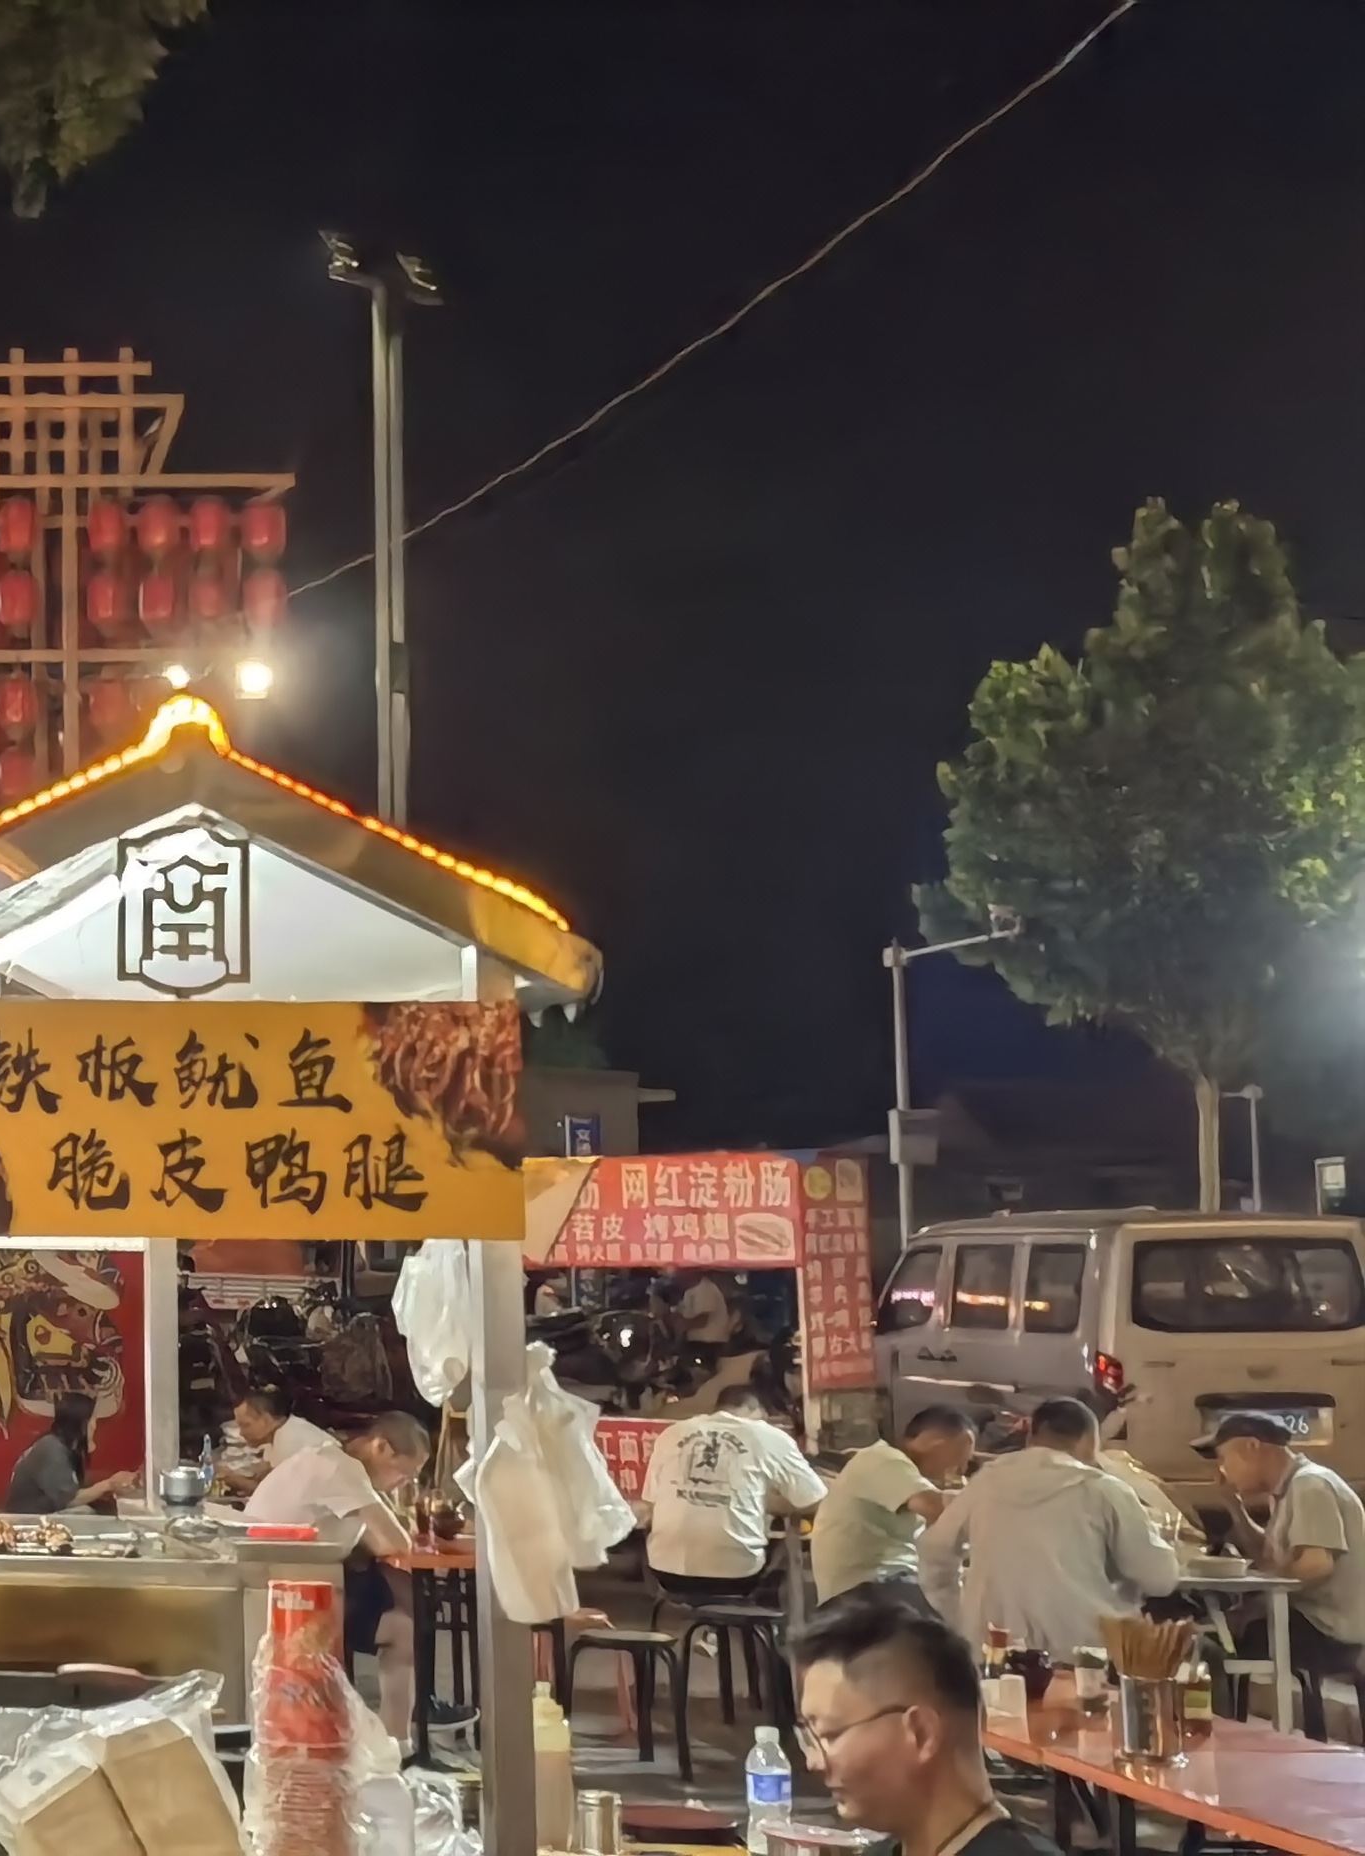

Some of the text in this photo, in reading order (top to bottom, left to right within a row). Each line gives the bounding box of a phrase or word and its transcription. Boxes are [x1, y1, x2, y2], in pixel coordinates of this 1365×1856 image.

[48, 1124, 429, 1214] 脆皮鸭腿
[621, 1159, 791, 1208] 网红淀粉肠
